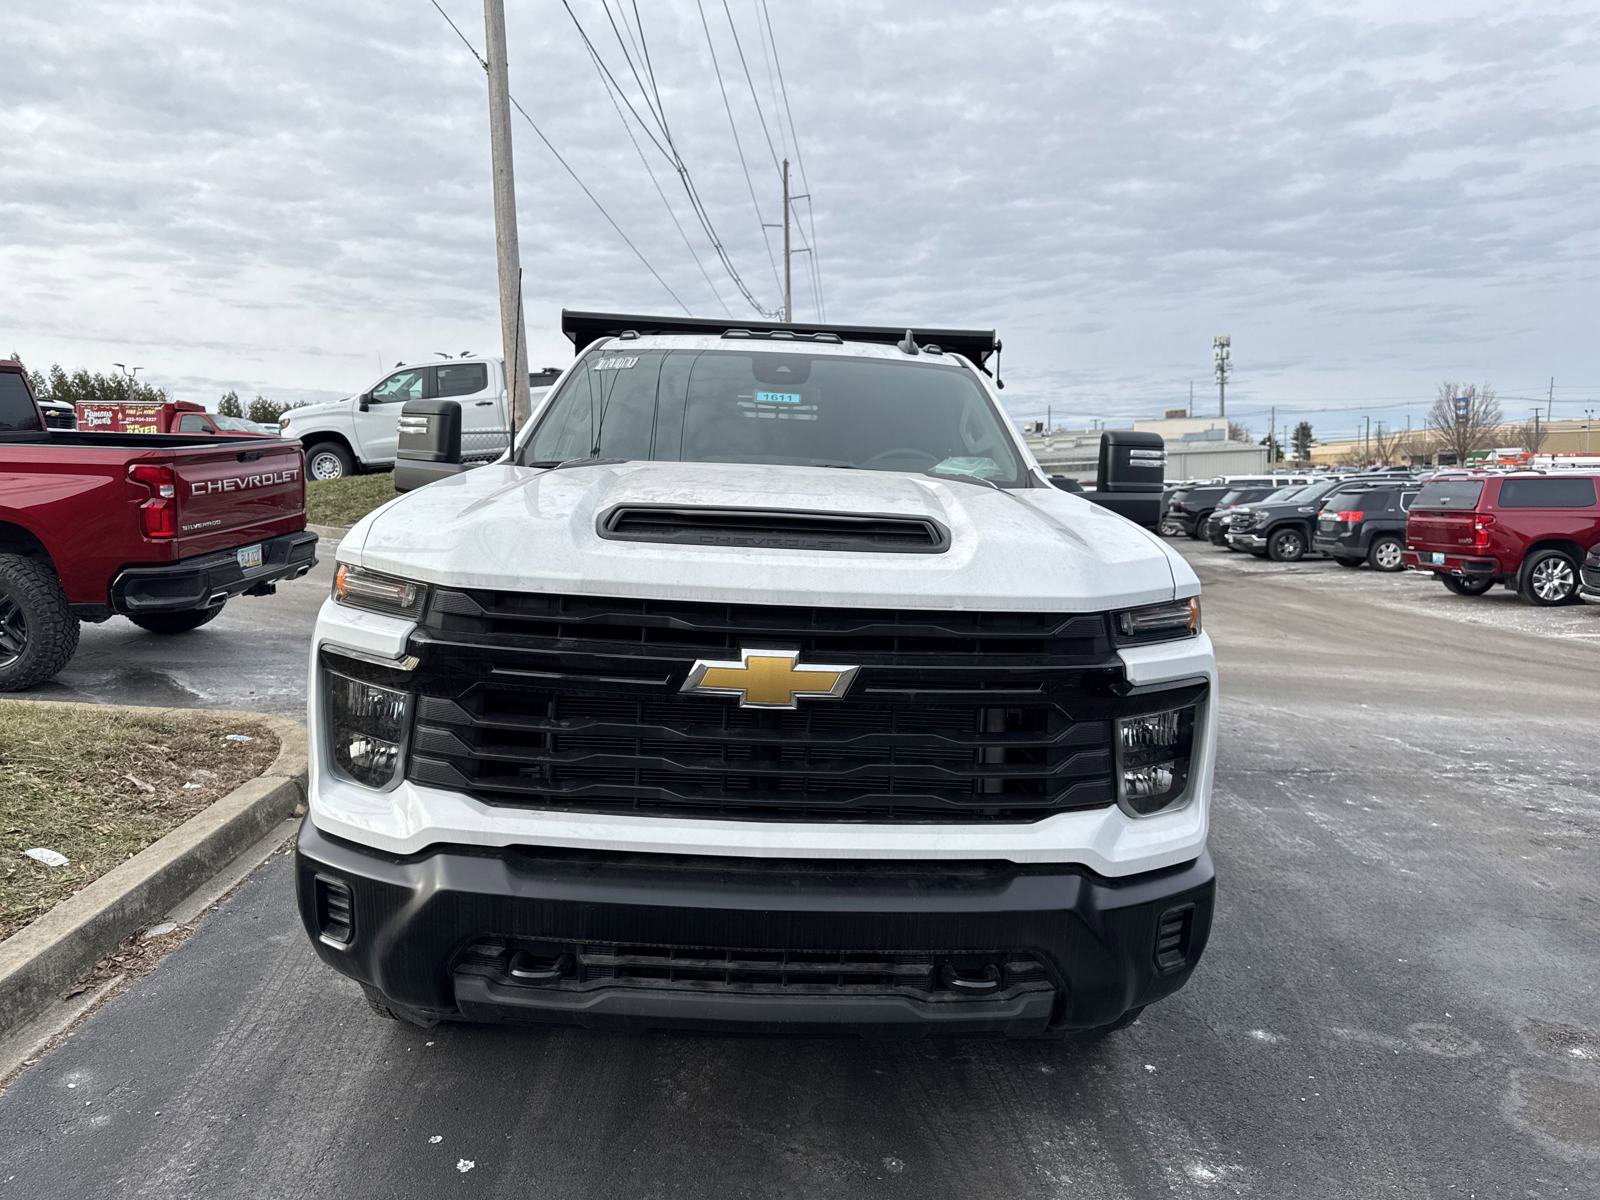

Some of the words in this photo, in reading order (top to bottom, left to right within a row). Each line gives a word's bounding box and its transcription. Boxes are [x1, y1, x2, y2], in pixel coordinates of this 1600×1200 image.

[763, 393, 792, 402] 1611
[84, 408, 113, 419] Famous
[191, 469, 299, 496] CHEVROLET
[699, 535, 848, 550] CHEVROLET
